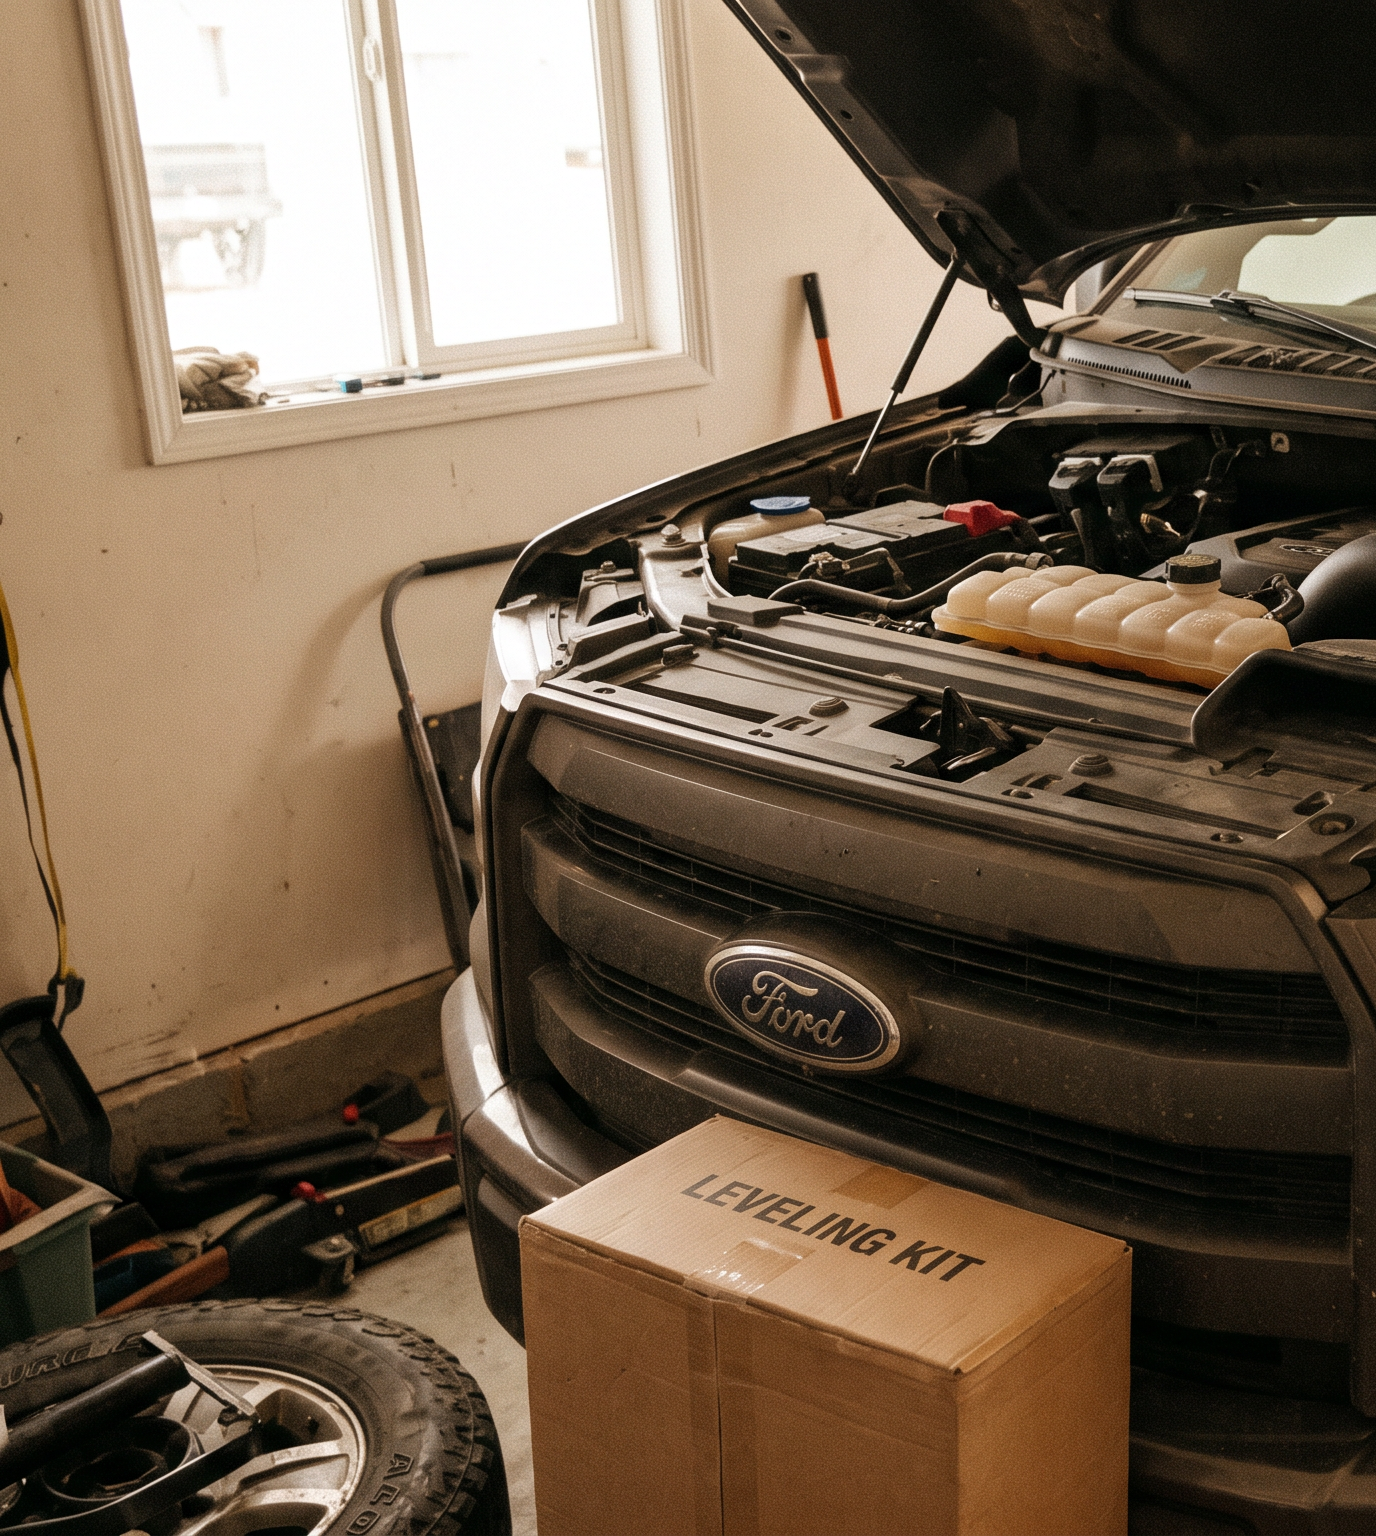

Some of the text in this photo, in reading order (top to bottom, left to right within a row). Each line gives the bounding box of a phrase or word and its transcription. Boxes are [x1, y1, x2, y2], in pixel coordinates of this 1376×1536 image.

[742, 970, 845, 1048] Ford
[680, 1173, 987, 1282] LEVELING KIT
